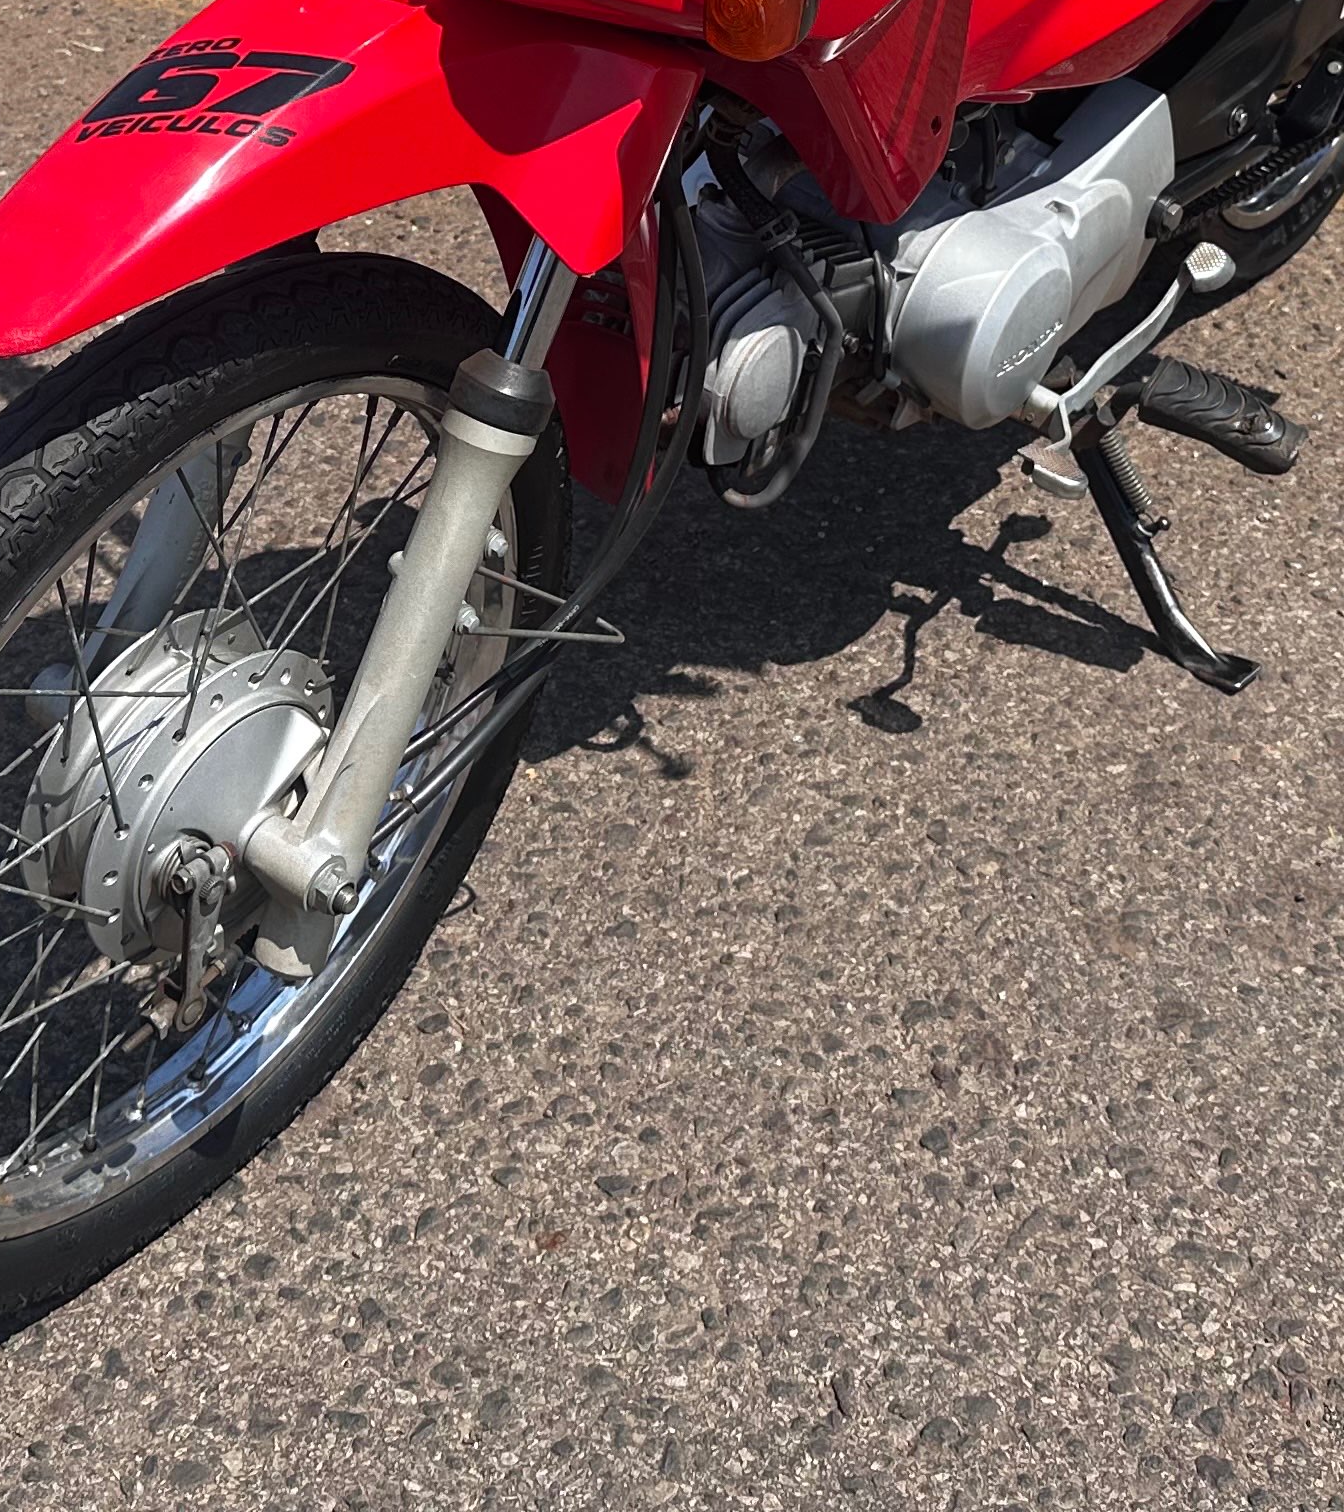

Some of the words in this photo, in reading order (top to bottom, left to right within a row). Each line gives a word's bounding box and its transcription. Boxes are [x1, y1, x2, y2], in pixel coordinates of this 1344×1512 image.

[138, 37, 243, 66] ZERO
[81, 50, 356, 124] 67
[74, 113, 298, 148] VEICULOS
